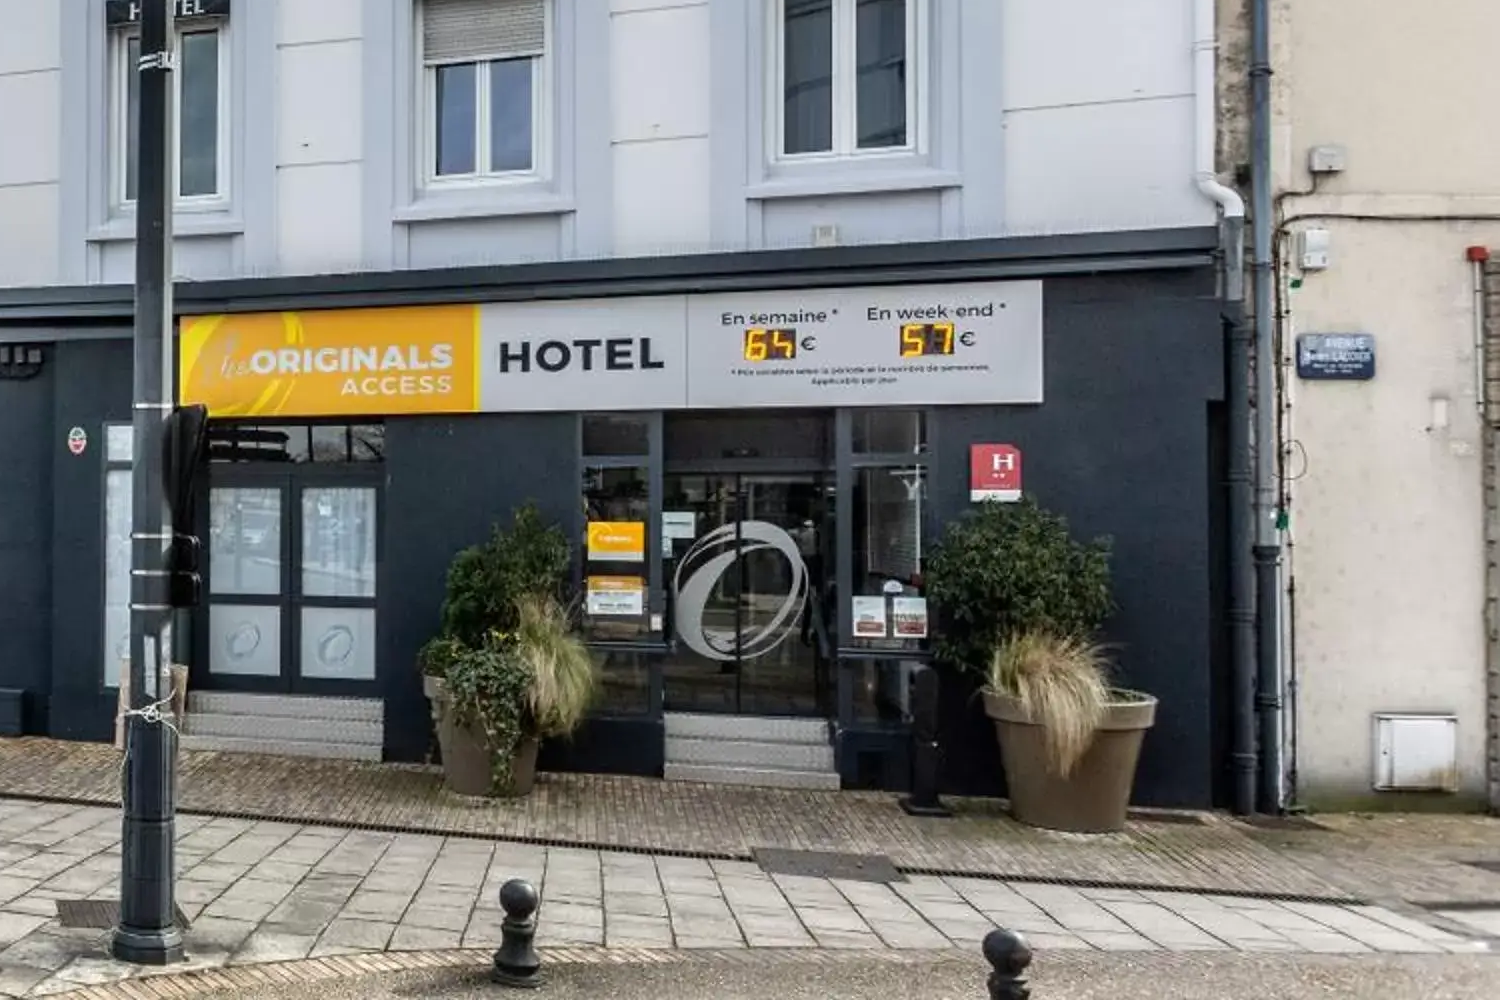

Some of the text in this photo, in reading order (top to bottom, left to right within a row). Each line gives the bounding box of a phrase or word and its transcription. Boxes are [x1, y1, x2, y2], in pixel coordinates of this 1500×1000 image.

[721, 312, 745, 326] En
[867, 307, 891, 321] En
[250, 343, 452, 375] ORIGINALS
[500, 337, 665, 373] HOTEL
[341, 375, 452, 396] ACCESS
[992, 453, 1015, 471] H
